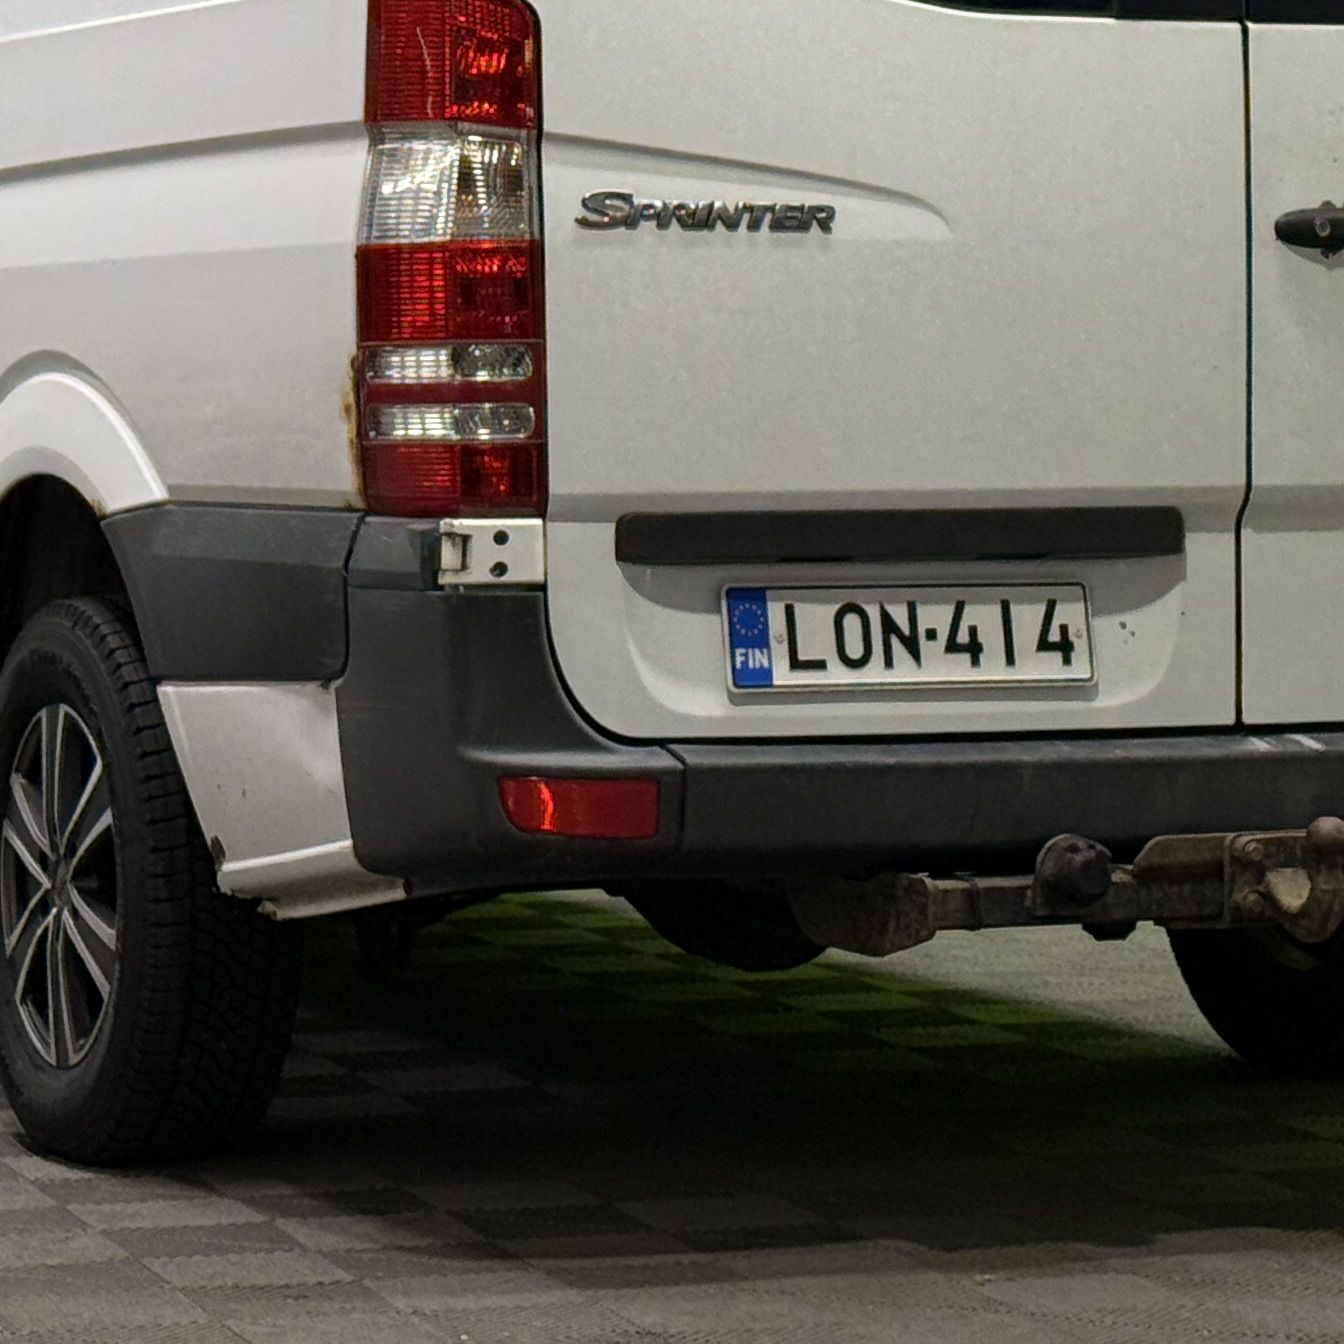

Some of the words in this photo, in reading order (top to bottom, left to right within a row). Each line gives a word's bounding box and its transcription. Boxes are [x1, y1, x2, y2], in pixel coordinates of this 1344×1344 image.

[574, 188, 837, 234] SPRINTER
[784, 598, 1076, 672] LON-414
[735, 647, 769, 670] FIN
